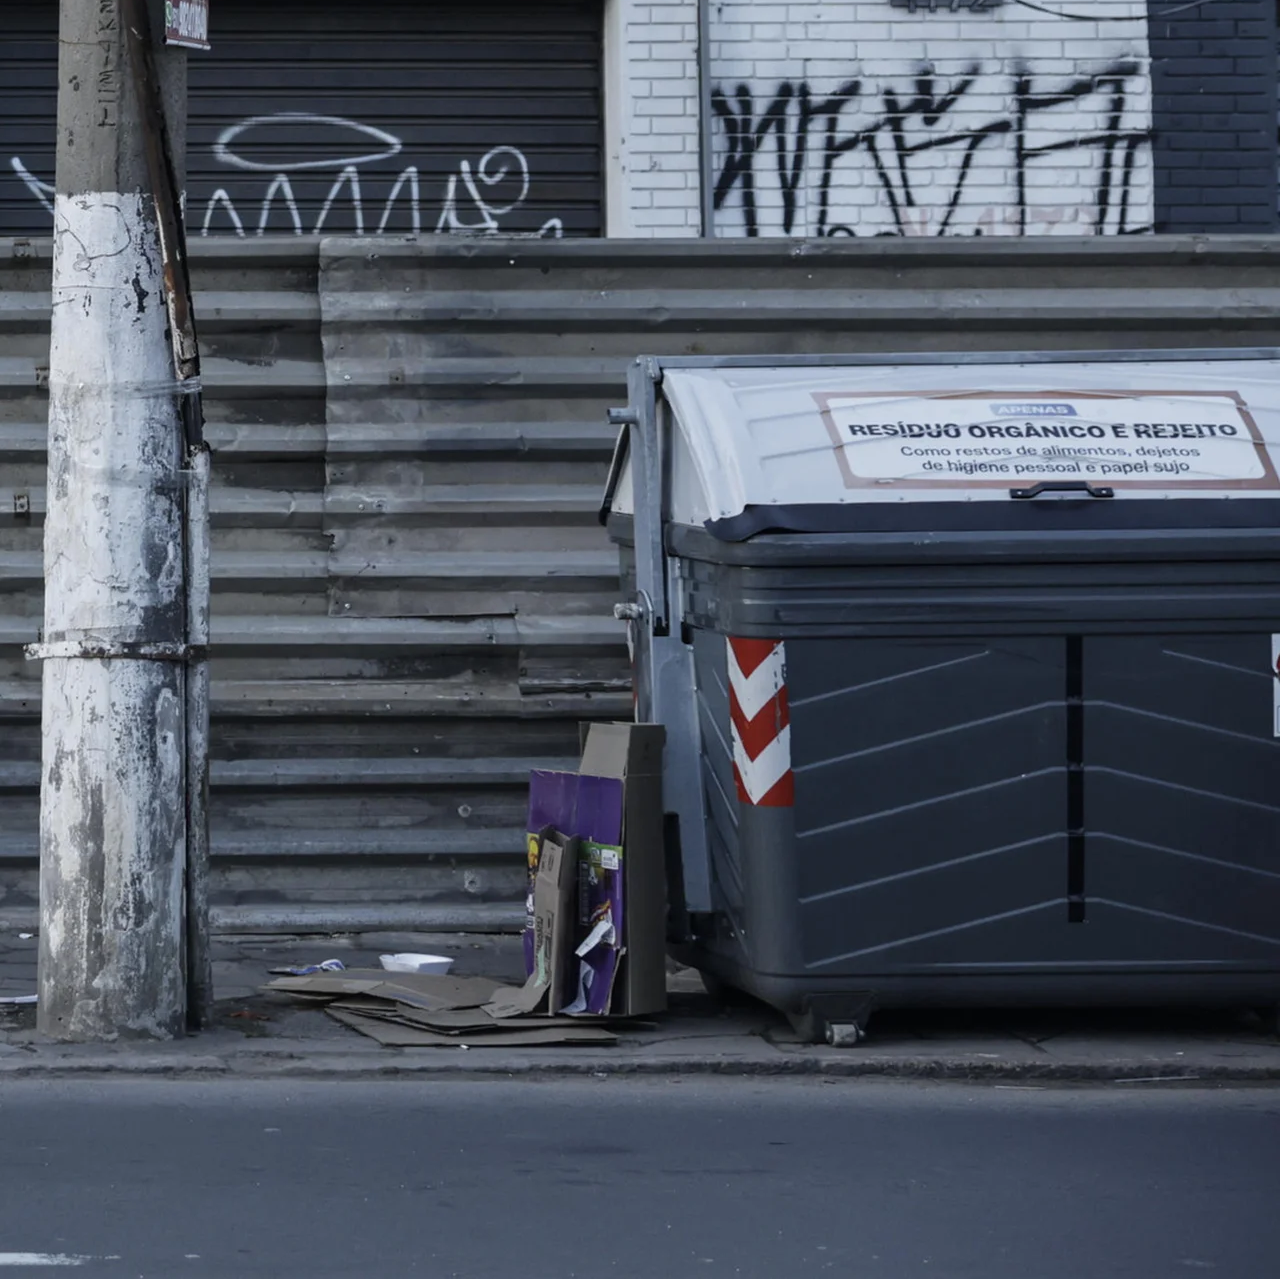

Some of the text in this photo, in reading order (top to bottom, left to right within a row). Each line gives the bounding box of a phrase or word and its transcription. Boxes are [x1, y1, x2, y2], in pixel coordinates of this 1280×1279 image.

[997, 405, 1069, 415] APENAS
[848, 421, 1238, 439] RESÍDUO ORGÂNICO E REJEITO
[900, 445, 1201, 458] Como restos de alimentos, dejetos
[922, 459, 1190, 475] de higiene pessoal e papel sujo
